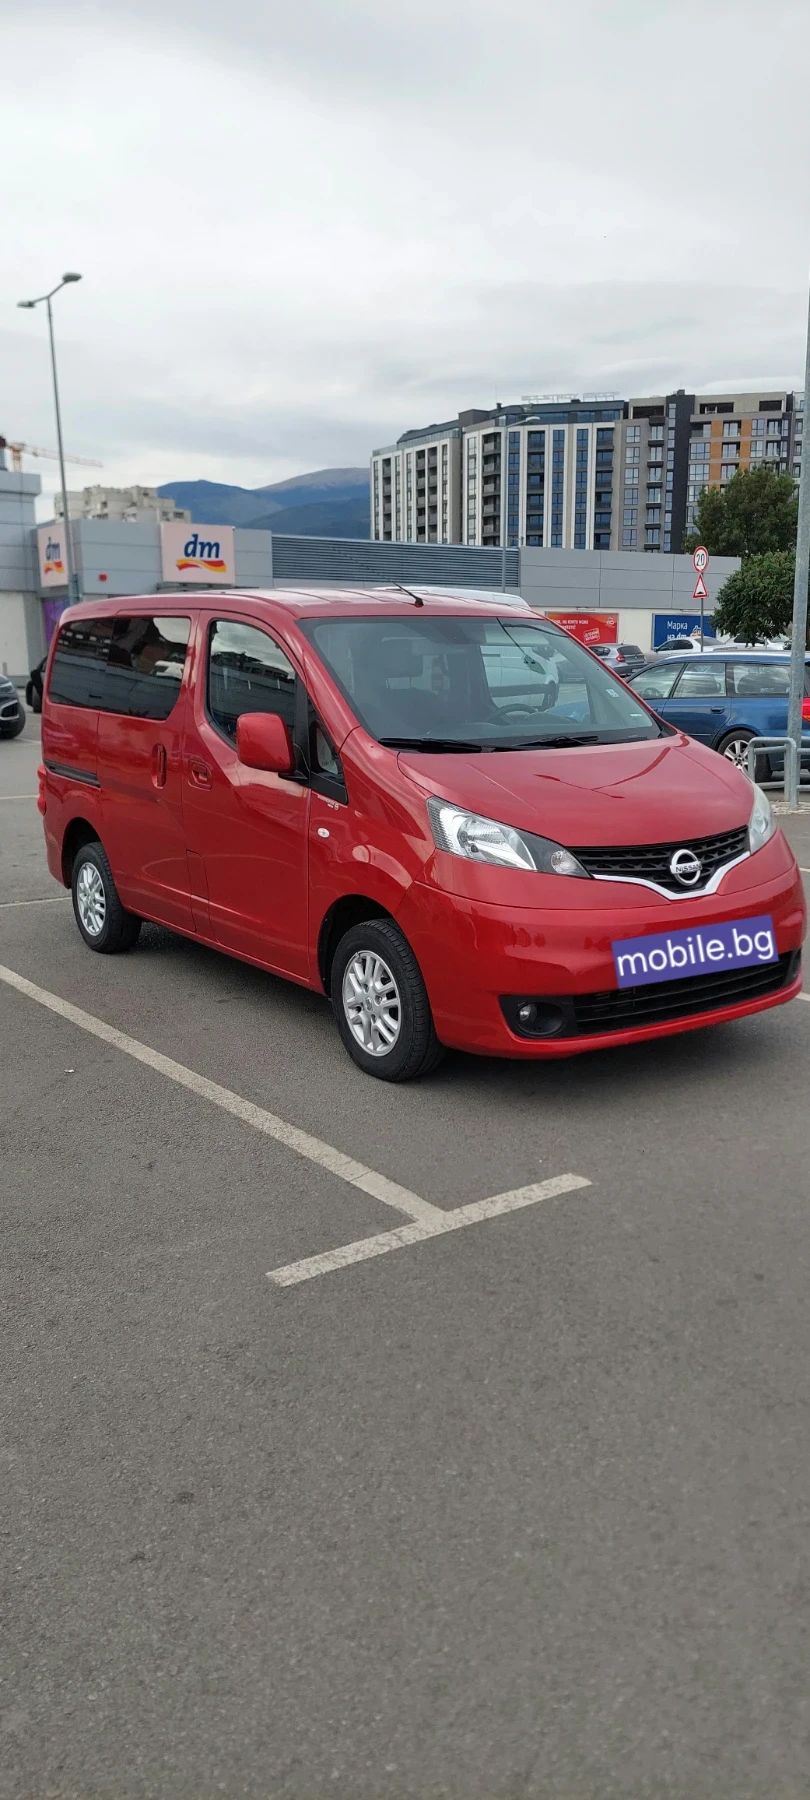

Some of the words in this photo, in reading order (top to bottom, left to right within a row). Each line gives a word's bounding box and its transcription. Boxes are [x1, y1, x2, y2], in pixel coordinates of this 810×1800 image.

[46, 537, 61, 560] dm
[184, 534, 220, 558] dm
[696, 554, 705, 566] 20
[667, 620, 688, 631] Марка
[675, 864, 700, 872] NISSAN
